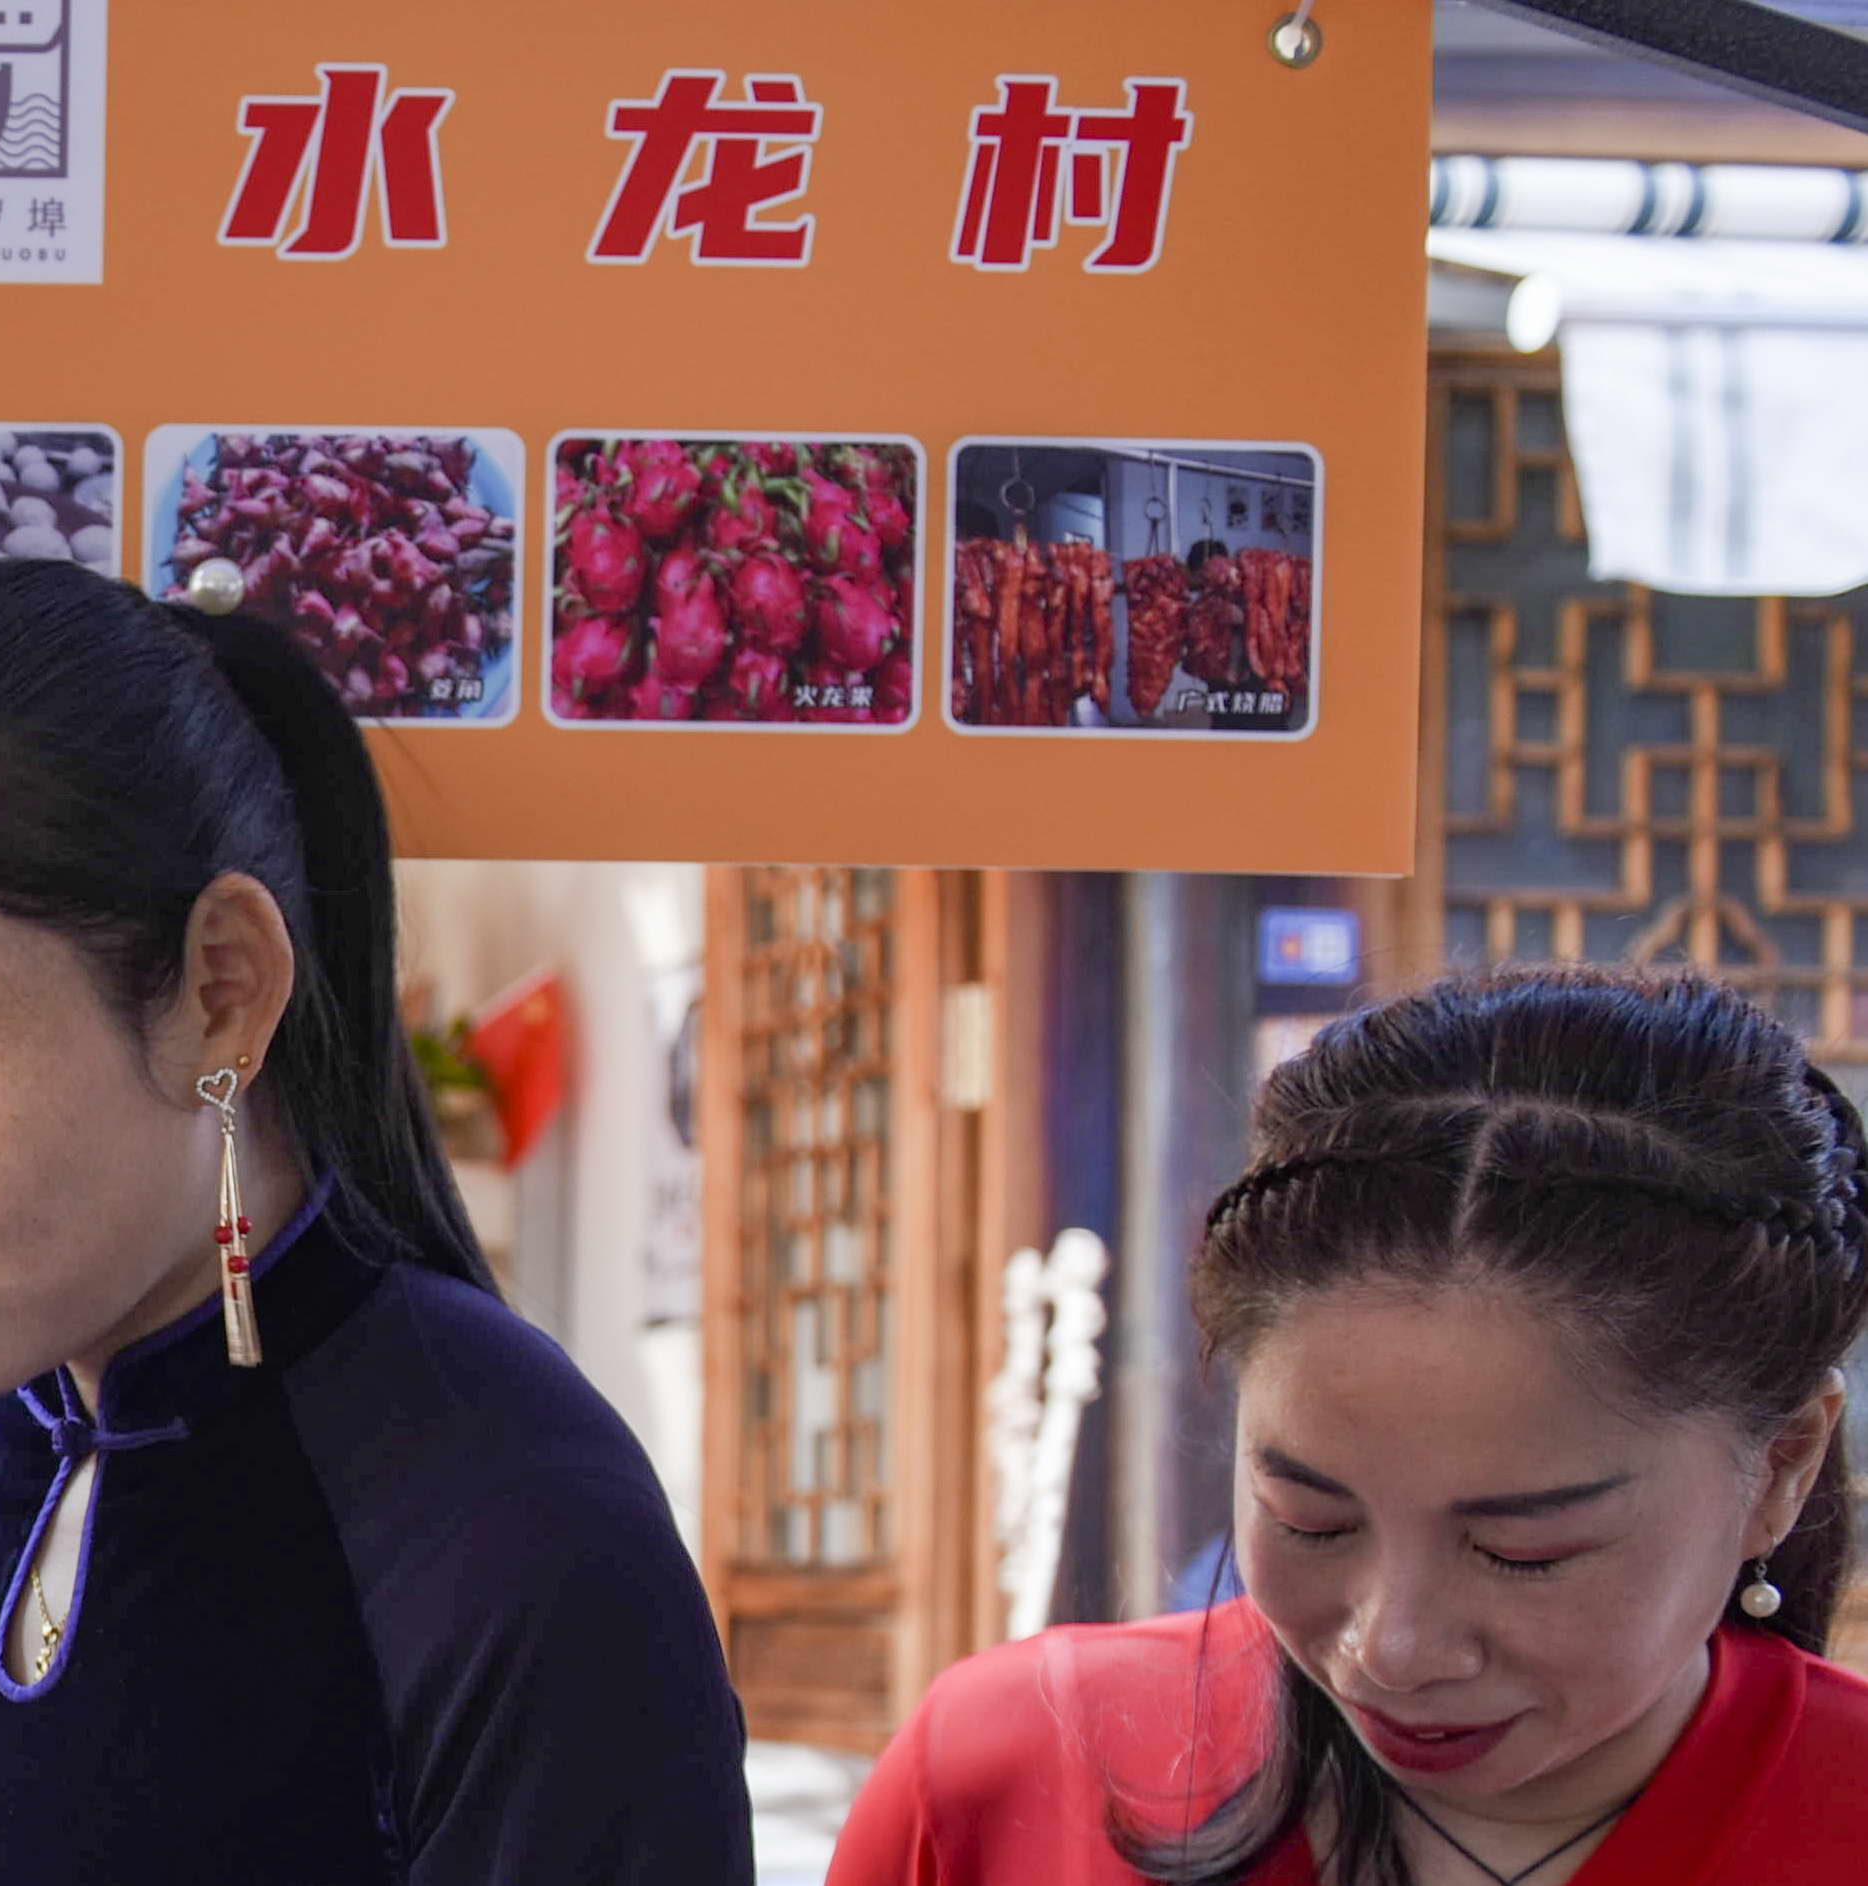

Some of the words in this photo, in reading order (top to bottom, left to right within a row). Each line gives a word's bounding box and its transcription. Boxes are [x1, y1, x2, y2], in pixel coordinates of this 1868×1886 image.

[218, 64, 1192, 272] 水龙村
[793, 684, 873, 708] 火龙果
[1177, 690, 1286, 715] 广式烧腊
